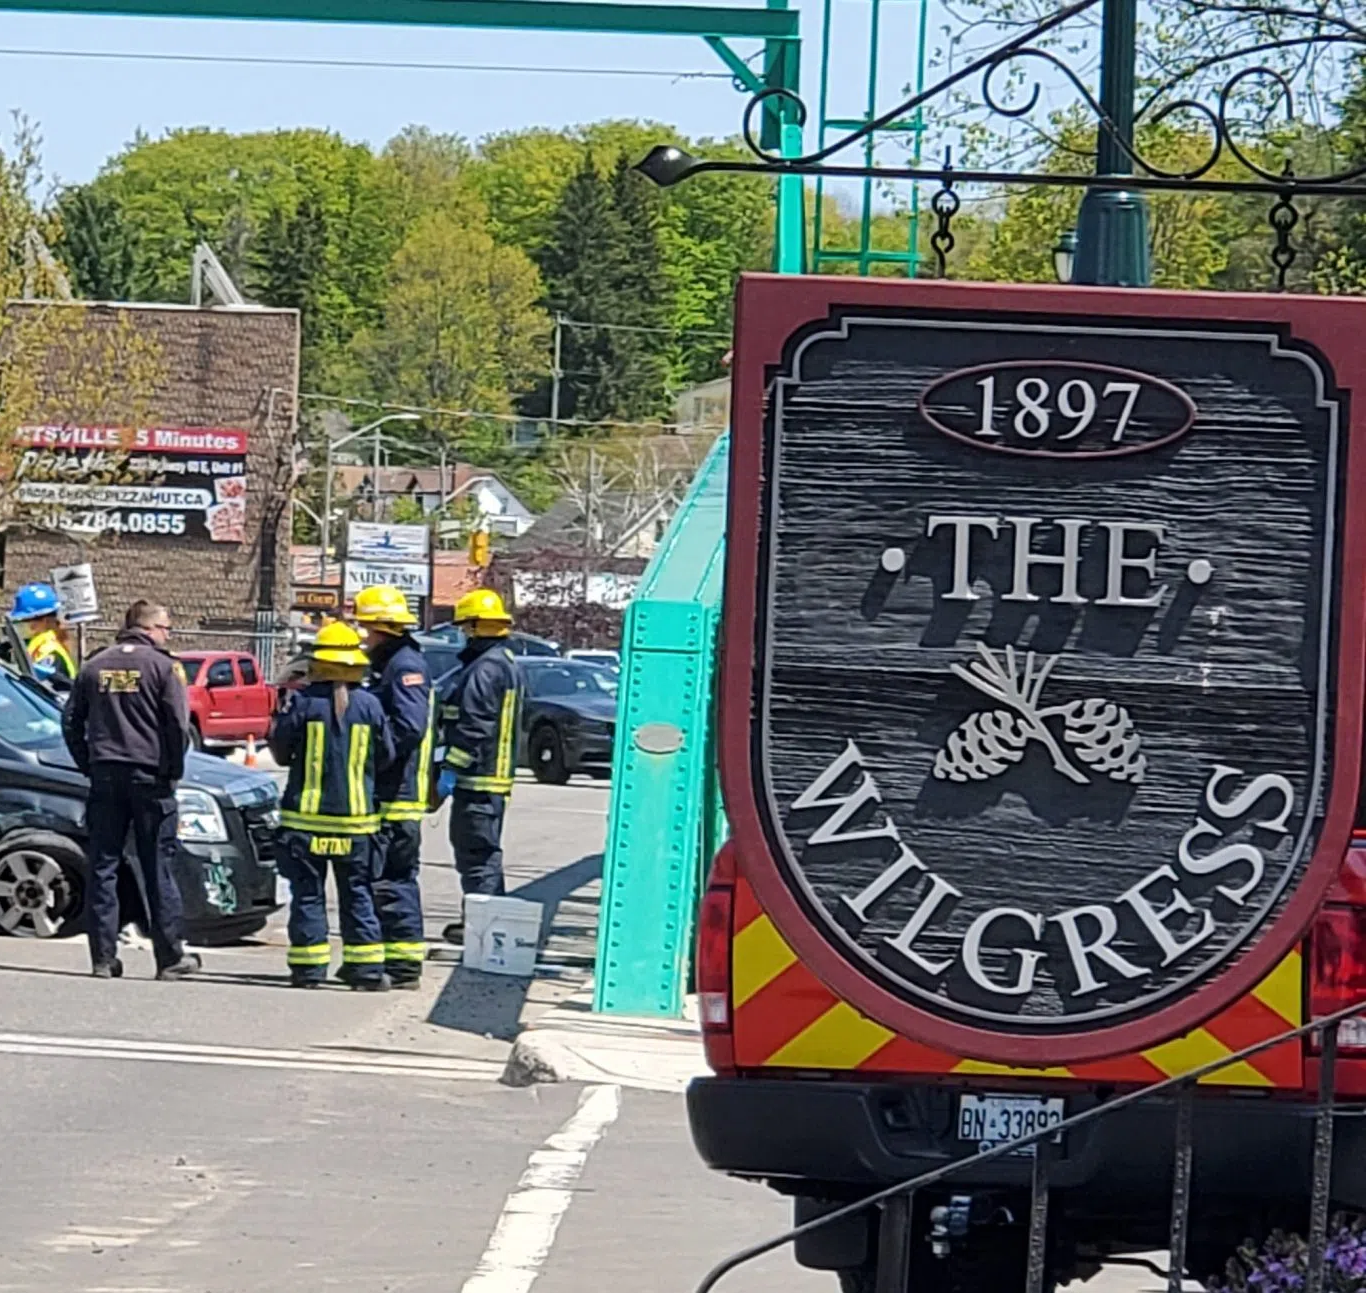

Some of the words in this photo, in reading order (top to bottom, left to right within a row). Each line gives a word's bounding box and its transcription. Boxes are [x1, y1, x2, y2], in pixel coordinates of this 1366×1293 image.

[136, 434, 150, 446] 5
[154, 431, 239, 450] Minutes
[974, 375, 1141, 441] 1897
[349, 571, 386, 585] NAILS
[400, 572, 423, 586] SPA
[927, 514, 1169, 607] THE
[789, 738, 1295, 998] WILGRESS
